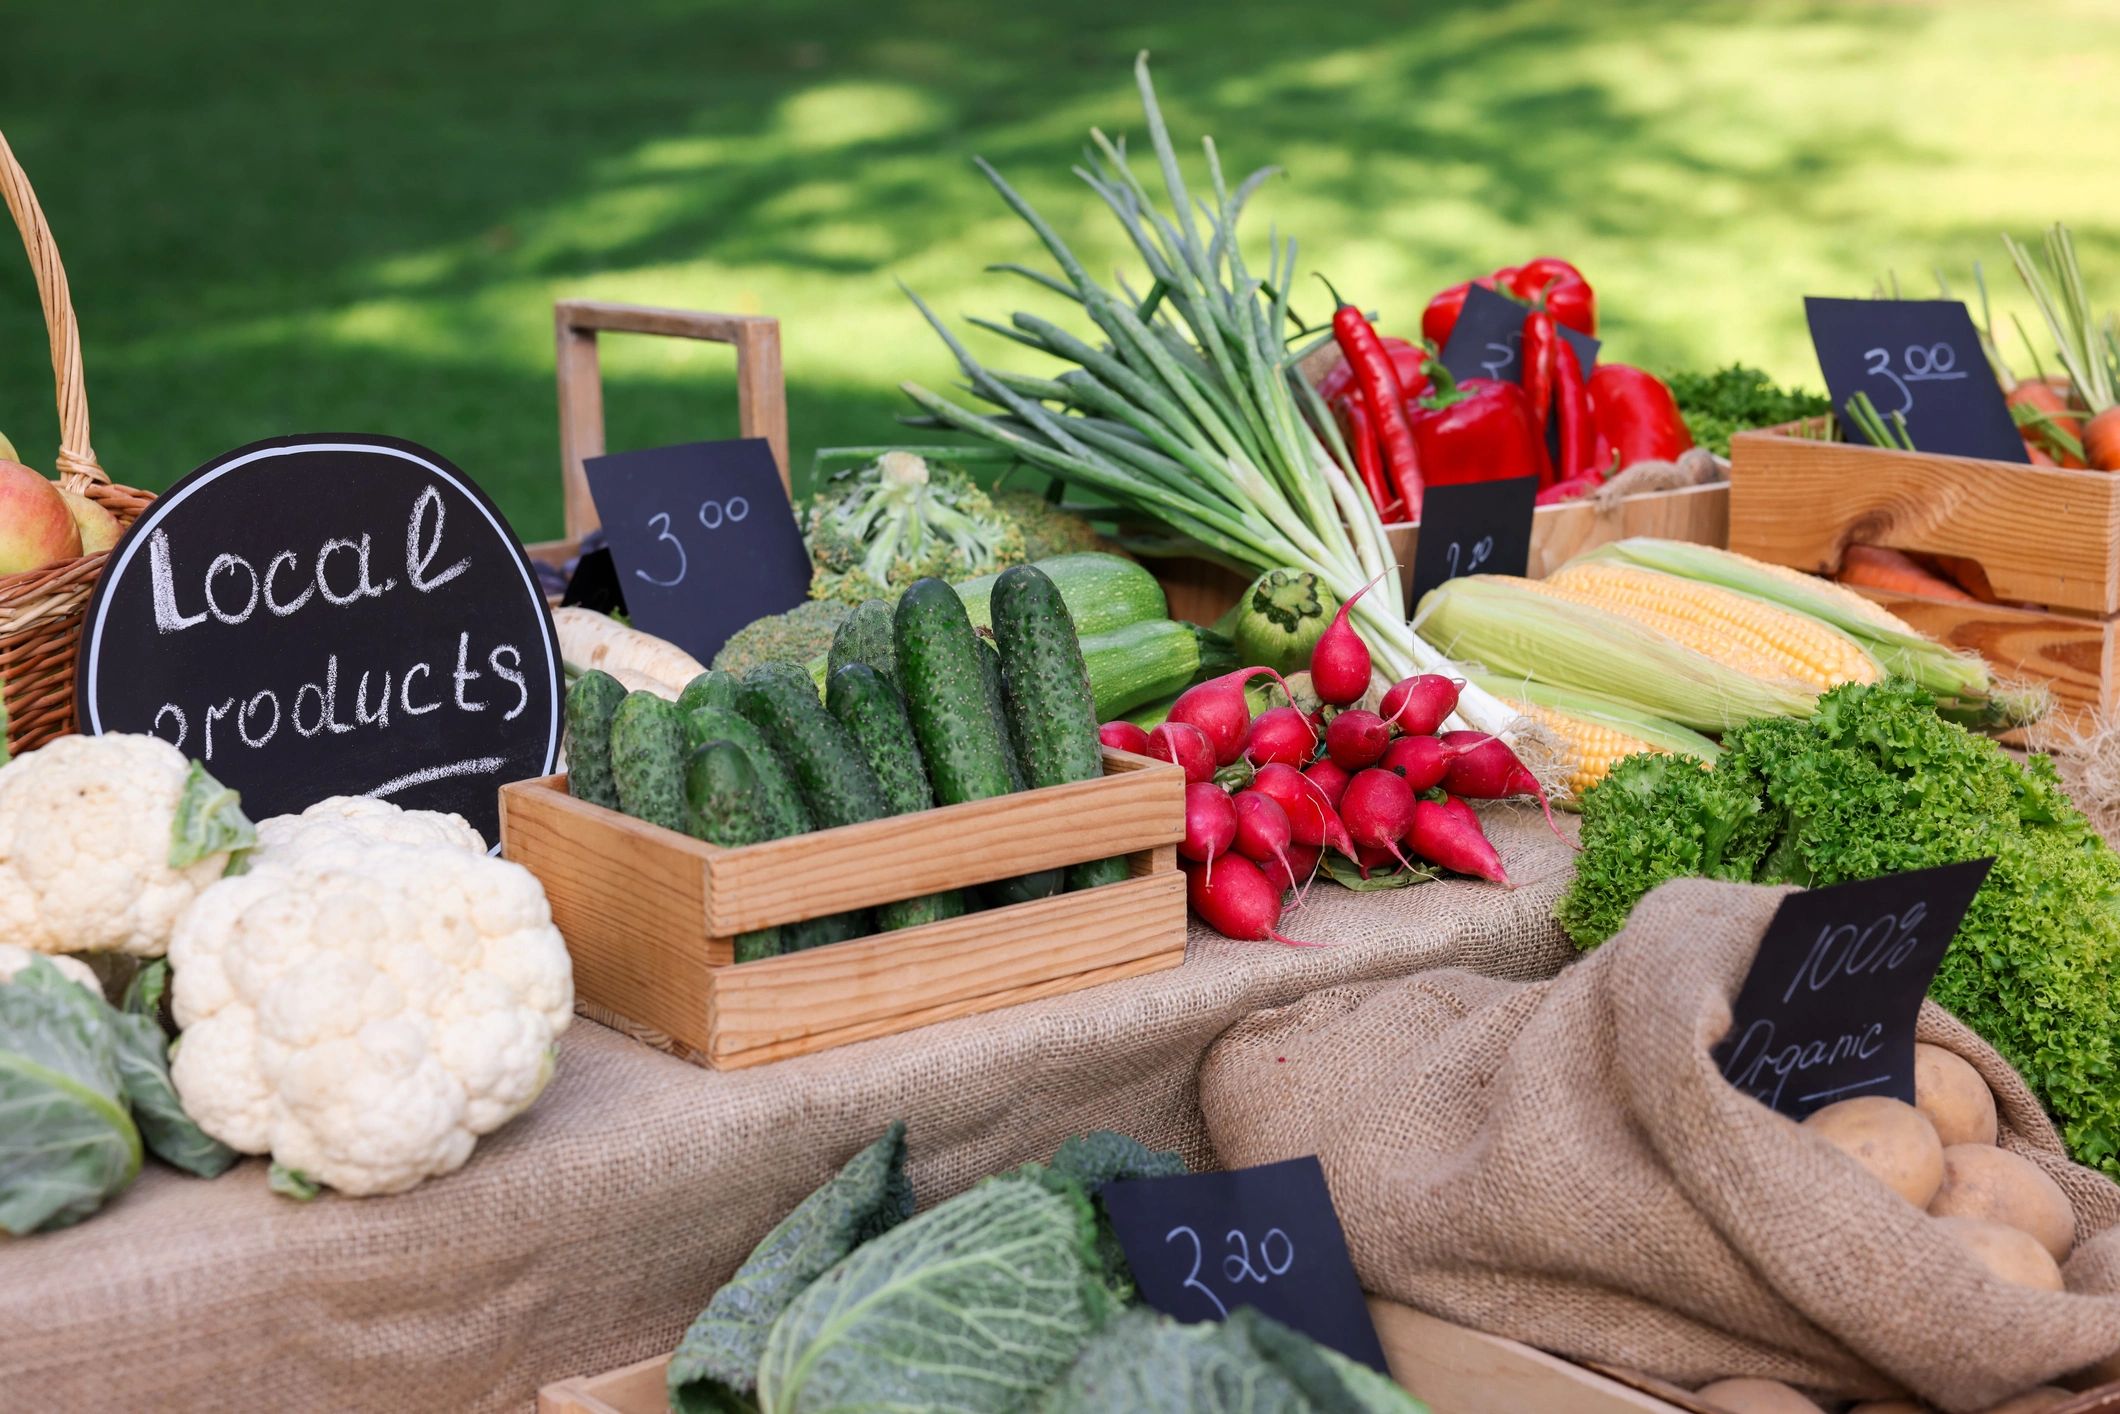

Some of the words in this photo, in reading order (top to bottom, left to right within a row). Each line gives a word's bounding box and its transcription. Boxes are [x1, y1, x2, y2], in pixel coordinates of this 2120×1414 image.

[150, 484, 473, 634] Local
[1783, 901, 1927, 1004] 100%
[1723, 1019, 1884, 1110] Organic
